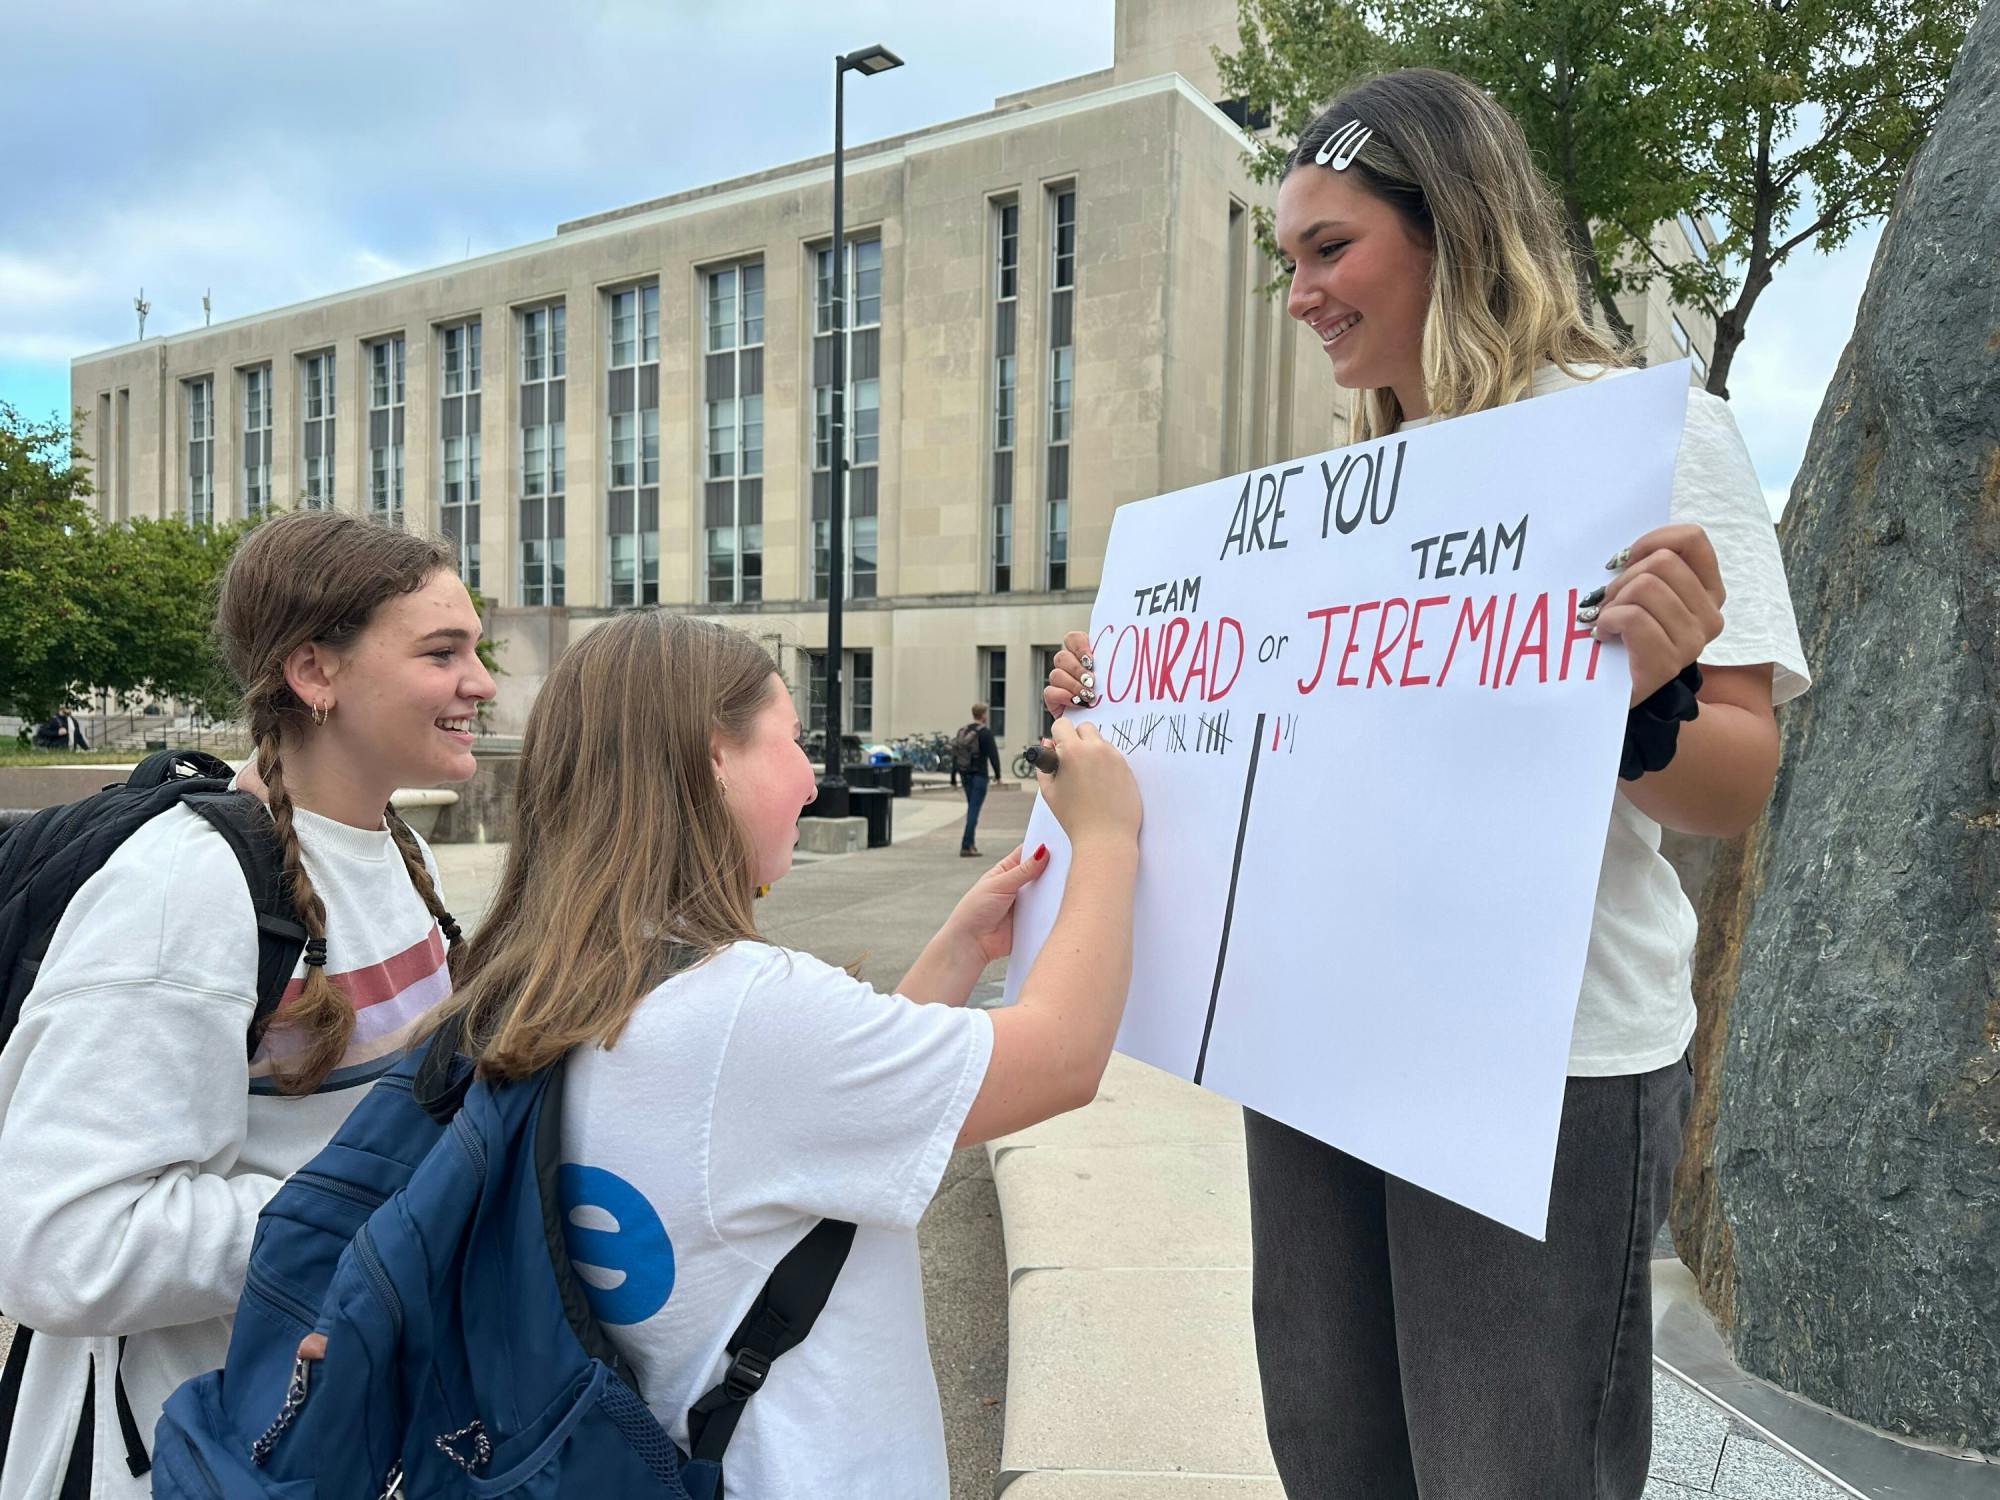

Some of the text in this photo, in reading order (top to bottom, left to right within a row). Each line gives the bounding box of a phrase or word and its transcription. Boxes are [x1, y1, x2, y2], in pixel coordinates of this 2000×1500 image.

[1220, 440, 1408, 561] ARE YOU
[1411, 513, 1529, 581] TEAM
[1134, 575, 1202, 617] TEAM
[1258, 634, 1289, 664] or
[1298, 586, 1602, 695] JEREMIAH
